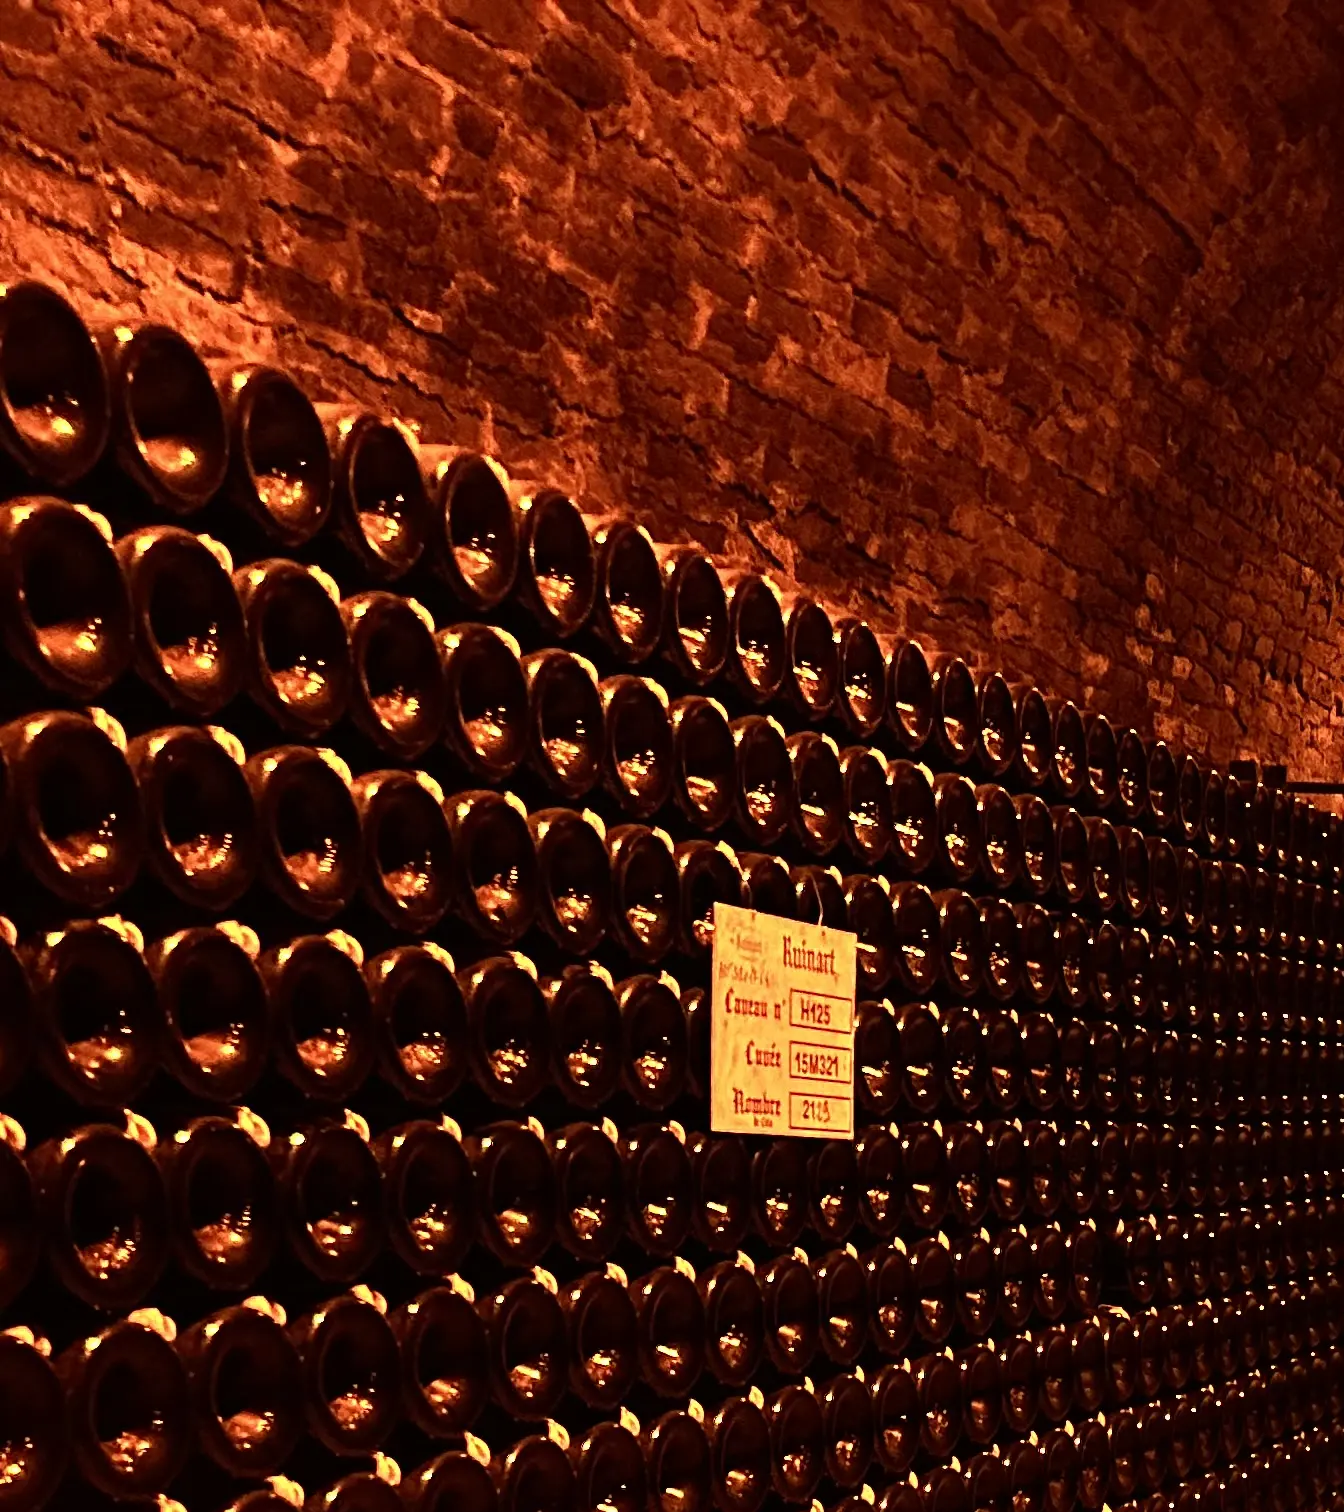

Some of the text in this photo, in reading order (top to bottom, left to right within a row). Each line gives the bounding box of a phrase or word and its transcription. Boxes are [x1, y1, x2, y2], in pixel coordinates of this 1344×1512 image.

[783, 935, 838, 976] Ruinart
[725, 987, 768, 1018] Caveau
[800, 997, 832, 1026] H125
[745, 1040, 839, 1077] Cuvée 15M321
[732, 1087, 782, 1116] Nombre
